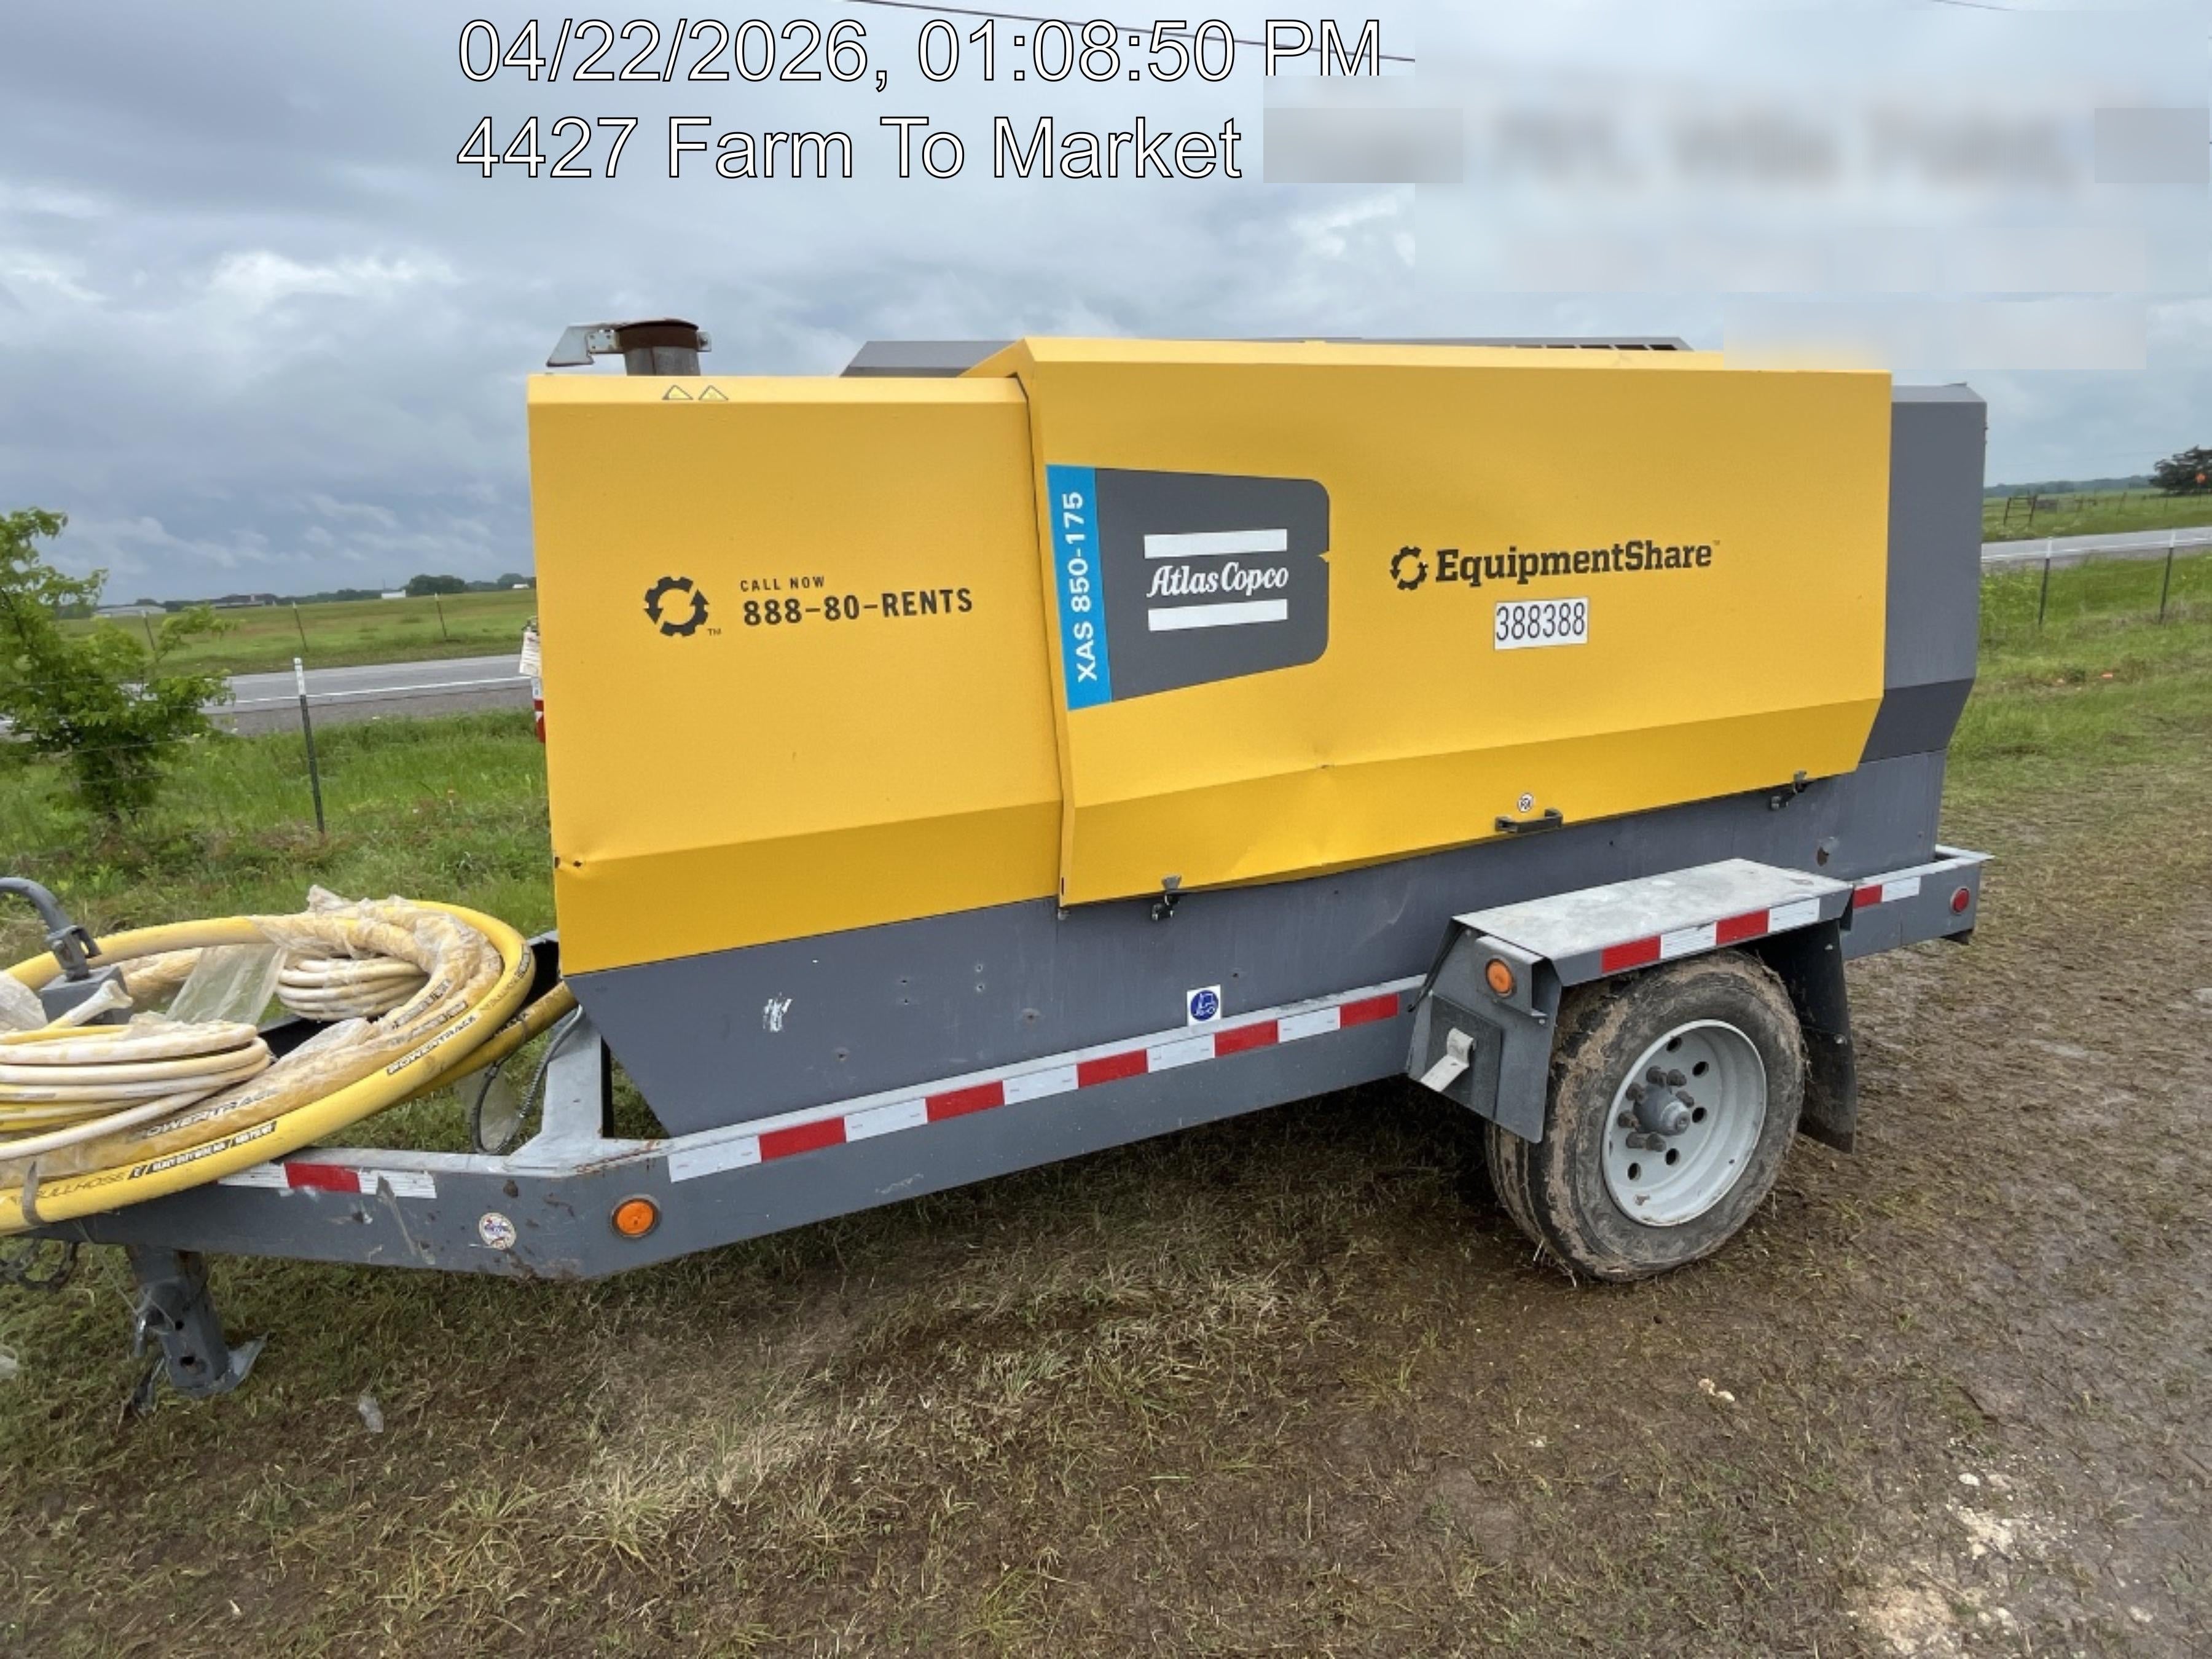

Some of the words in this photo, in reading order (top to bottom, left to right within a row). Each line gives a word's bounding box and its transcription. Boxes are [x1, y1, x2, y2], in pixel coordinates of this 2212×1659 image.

[1062, 491, 1091, 613] 850-175
[1435, 539, 1712, 587] EquipmentShare
[740, 578, 781, 592] CALL
[789, 576, 825, 589] NOW
[742, 587, 973, 627] 888-80-RENTS
[1496, 602, 1585, 641] 388388
[1072, 622, 1098, 683] XAS
